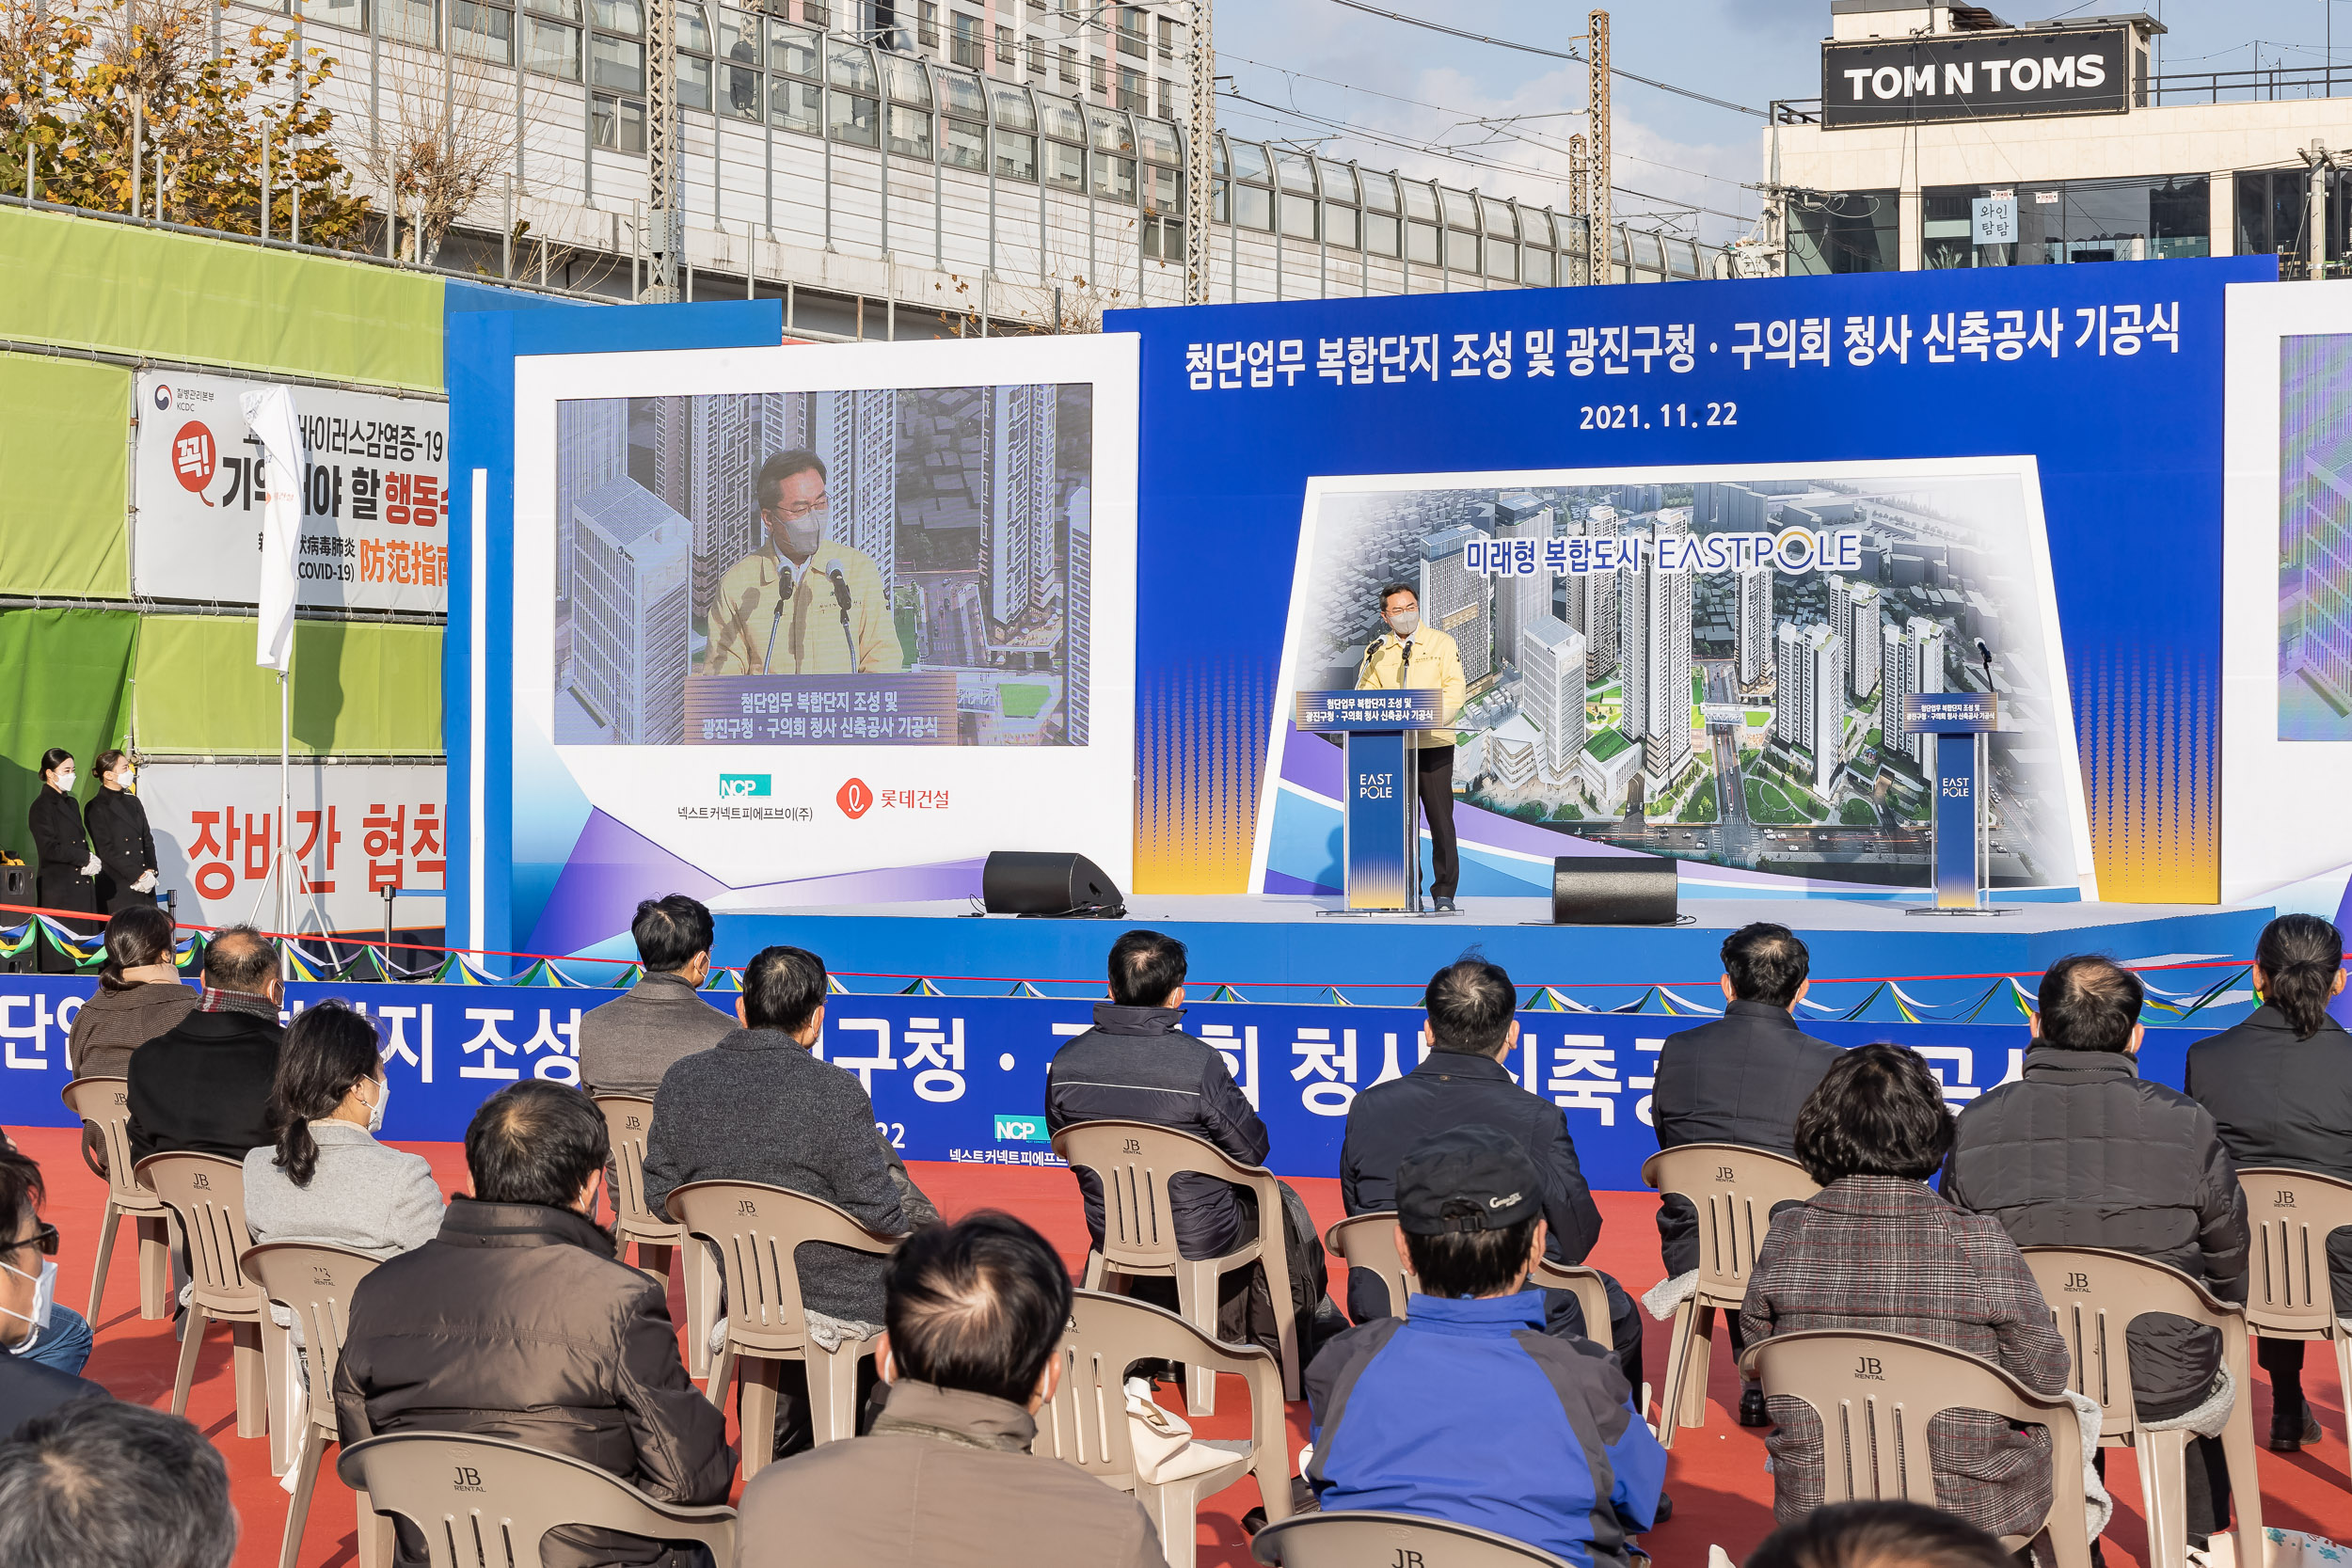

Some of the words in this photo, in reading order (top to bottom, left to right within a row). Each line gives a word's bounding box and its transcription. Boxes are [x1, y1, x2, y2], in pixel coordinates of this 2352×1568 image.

[1844, 65, 1935, 101] TOM
[1946, 62, 1973, 95] N
[1981, 55, 2106, 92] TOMS
[1980, 203, 2007, 220] 와인
[1981, 220, 2010, 237] 탐탐
[1185, 339, 1306, 390] 첨단업무
[1317, 333, 1438, 386] 복합단지
[1452, 330, 1512, 380] 조성
[1525, 328, 1555, 378] 및
[1565, 324, 1695, 376] 광진구청
[1731, 317, 1831, 371] 구의회
[1843, 314, 1913, 367] 청사
[1922, 307, 2064, 363] 신축공사
[2074, 301, 2180, 356] 기공식
[177, 388, 215, 403] 질병관리본부
[176, 403, 195, 412] KCDC
[1580, 404, 1650, 430] 2021.
[1661, 404, 1698, 429] 11.
[1707, 402, 1738, 426] 22
[177, 435, 210, 478] 꼭!
[351, 466, 381, 521] 할
[385, 471, 448, 528] 행동
[1468, 538, 1536, 574] 미래형
[1544, 538, 1641, 572] 복합도시
[1660, 531, 1859, 570] EASTPOLE
[297, 562, 355, 582] COVID-19)
[740, 691, 793, 714] 첨단업무
[797, 691, 850, 713] 복합단지
[854, 691, 881, 712] 조성
[884, 691, 898, 712] 및
[1327, 699, 1356, 709] 첨단업무
[1358, 698, 1387, 709] 복합단지
[1388, 698, 1403, 708] 조성
[1404, 698, 1412, 708] 및
[1305, 711, 1334, 722] 광진구청
[1341, 711, 1363, 721] 구의회
[1364, 710, 1379, 721] 청사
[1380, 710, 1410, 721] 신축공사
[1411, 709, 1434, 721] 기공식
[702, 718, 754, 739] 광진구청
[767, 718, 806, 738] 구의회
[810, 717, 836, 738] 청사
[840, 717, 895, 738] 신축공사
[898, 716, 938, 737] 기공식
[1359, 773, 1392, 785] EAST
[1943, 777, 1970, 787] EAST
[721, 780, 756, 797] NCP
[1359, 786, 1392, 800] POLE
[1943, 787, 1969, 798] POLE
[881, 789, 949, 809] 롯데건설
[626, 1116, 641, 1128] JB
[996, 1121, 1036, 1140] NCP
[1123, 1138, 1140, 1151] JB
[193, 1173, 209, 1187] JB
[1715, 1166, 1734, 1179] JB
[2274, 1191, 2295, 1204] JB
[738, 1200, 756, 1213] JB
[2064, 1273, 2089, 1288] JB
[1854, 1357, 1883, 1374] JB
[1854, 1373, 1885, 1382] RENTAL
[453, 1466, 482, 1486] JB
[1391, 1548, 1424, 1568] JB
